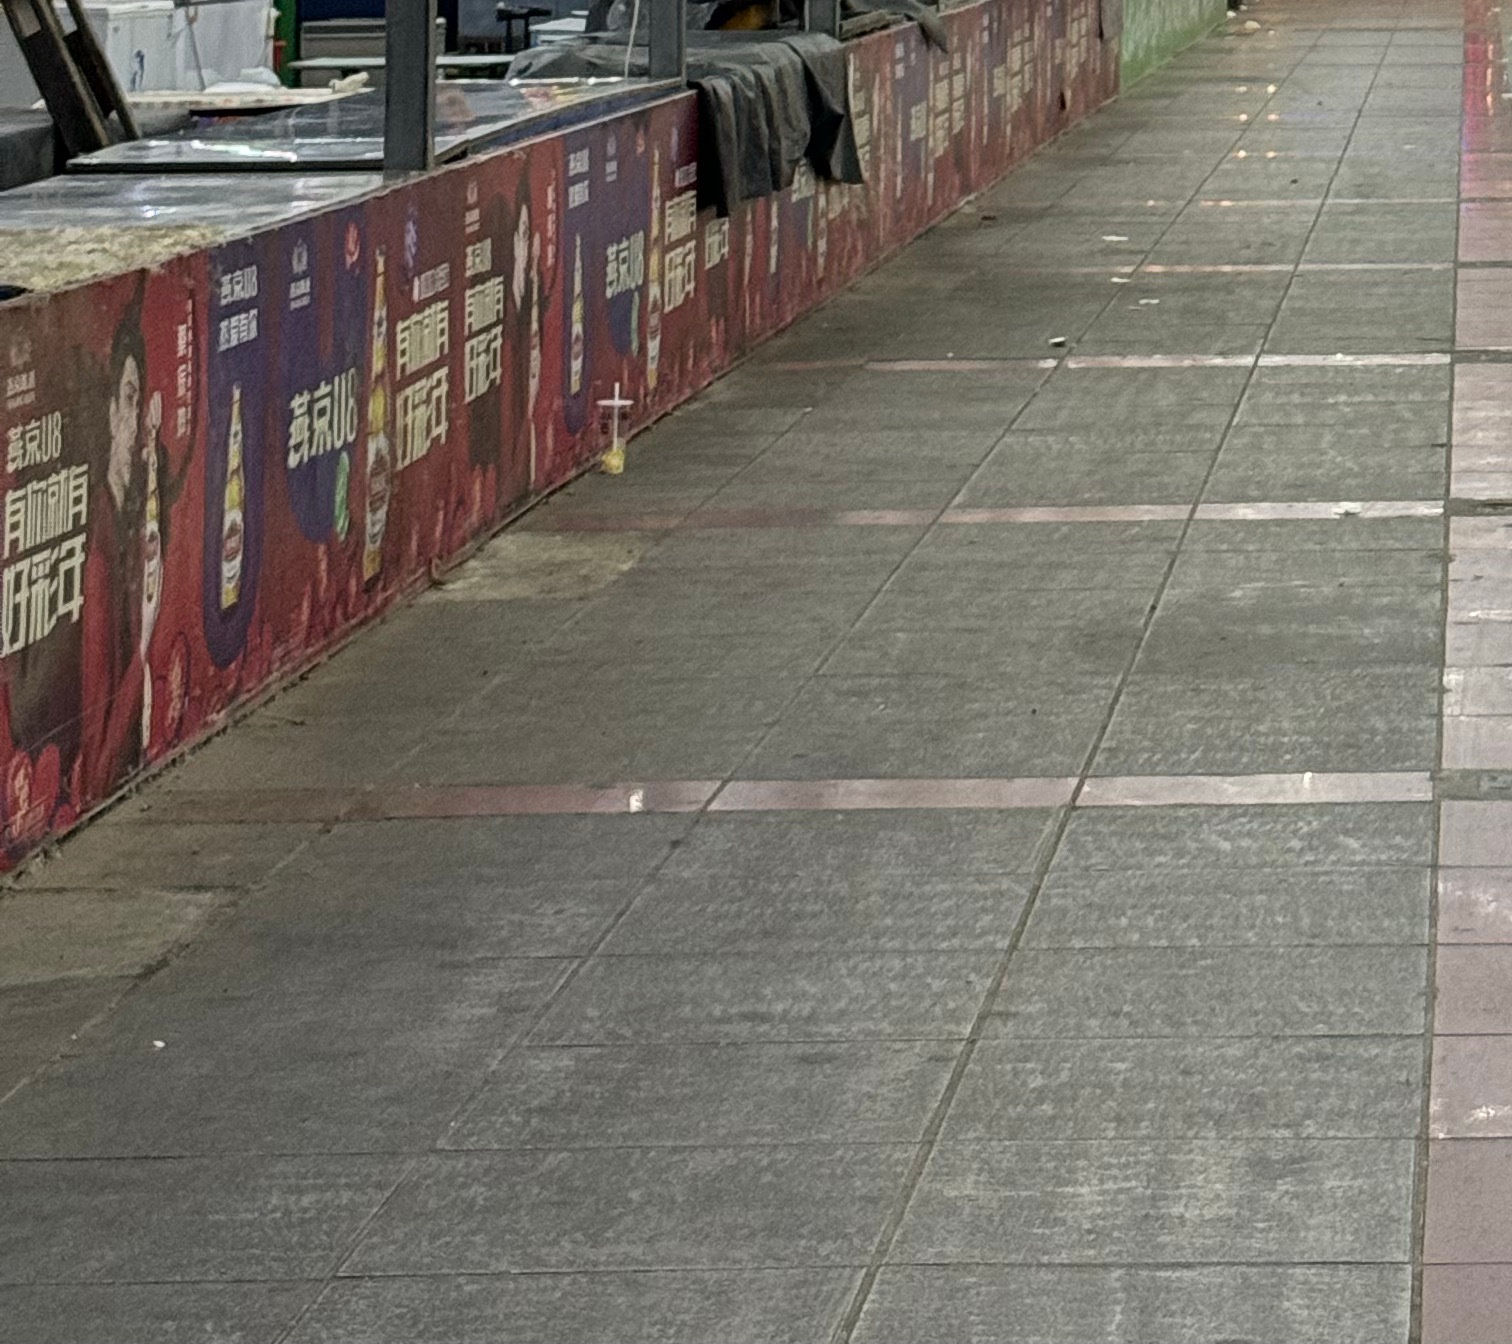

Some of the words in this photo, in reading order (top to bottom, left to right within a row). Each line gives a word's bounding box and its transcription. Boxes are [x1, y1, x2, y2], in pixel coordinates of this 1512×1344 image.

[605, 230, 645, 300] 燕京U8
[6, 410, 63, 474] 燕京U8
[287, 367, 358, 469] 燕京U8
[4, 463, 90, 560] 有你就有
